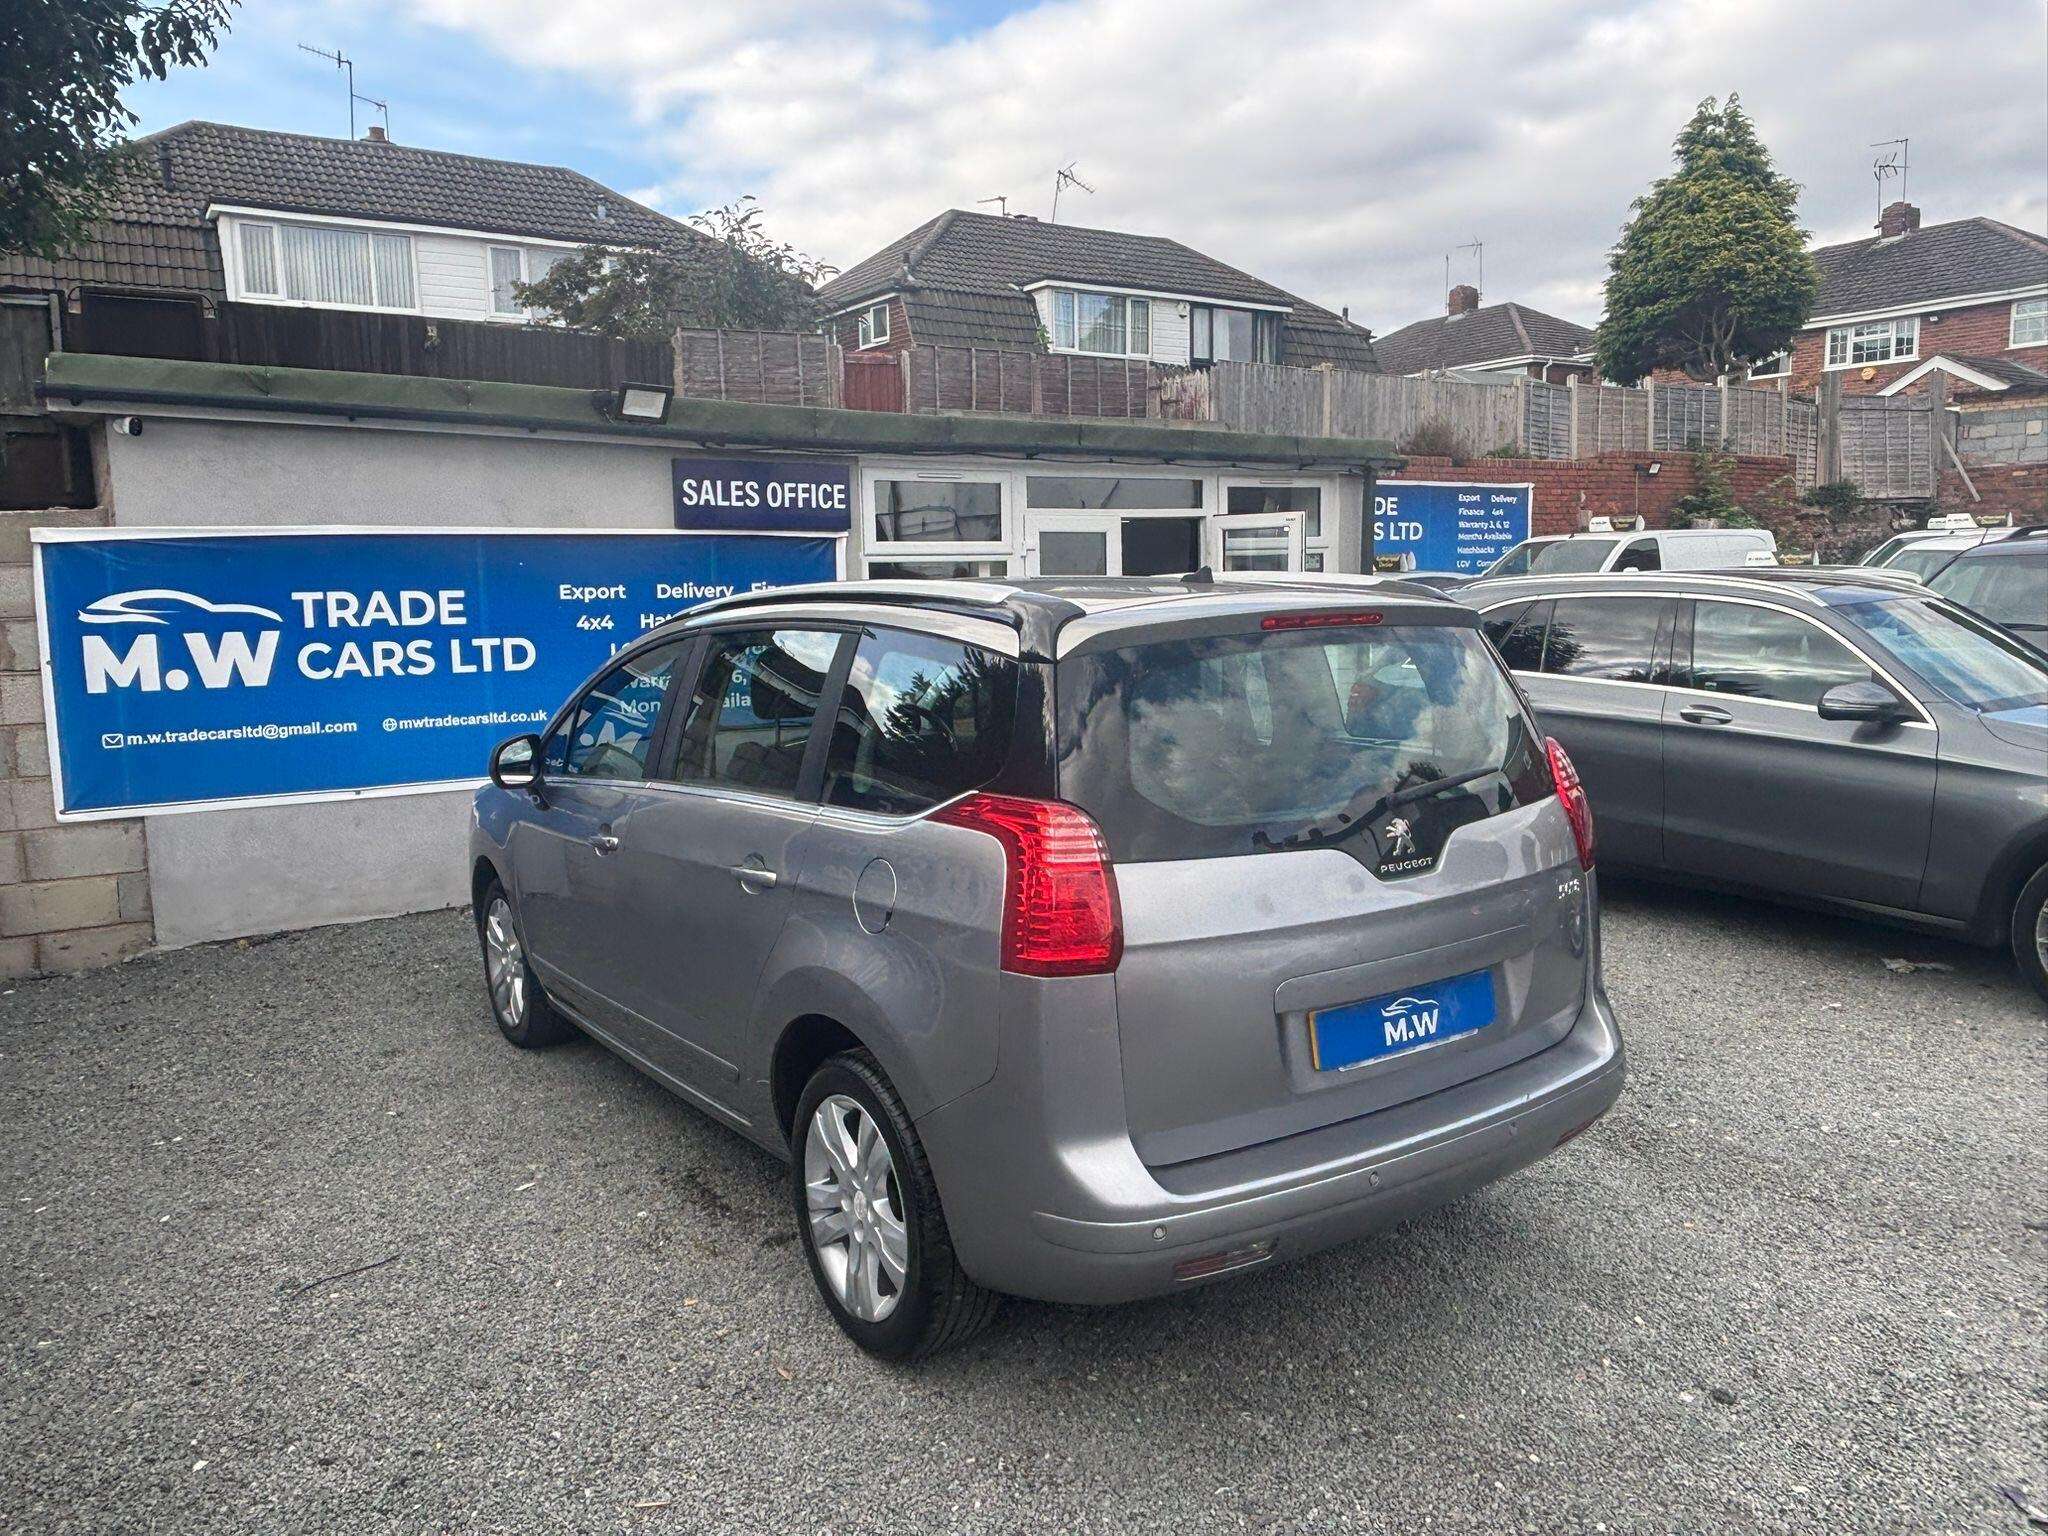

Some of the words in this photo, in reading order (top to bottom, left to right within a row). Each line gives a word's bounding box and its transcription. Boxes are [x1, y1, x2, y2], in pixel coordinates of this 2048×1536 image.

[682, 478, 760, 507] SALES
[766, 481, 846, 509] OFFICE
[1374, 496, 1398, 516] DE
[1458, 494, 1481, 503] Export
[1490, 494, 1518, 504] Delivery
[1389, 521, 1423, 541] LTD
[559, 583, 627, 603] Export
[656, 581, 734, 600] Delivery
[291, 589, 468, 628] TRADE
[576, 614, 615, 631] 4x4
[81, 630, 281, 694] M.W
[297, 639, 436, 679] CARS
[450, 637, 537, 673] LTD
[127, 720, 358, 746] m.w.tradecarsltd@gmail.com
[399, 709, 548, 729] mwtradecarsltd.co.uk
[1380, 857, 1433, 873] PEUGEOT
[1383, 1008, 1439, 1046] M.W
